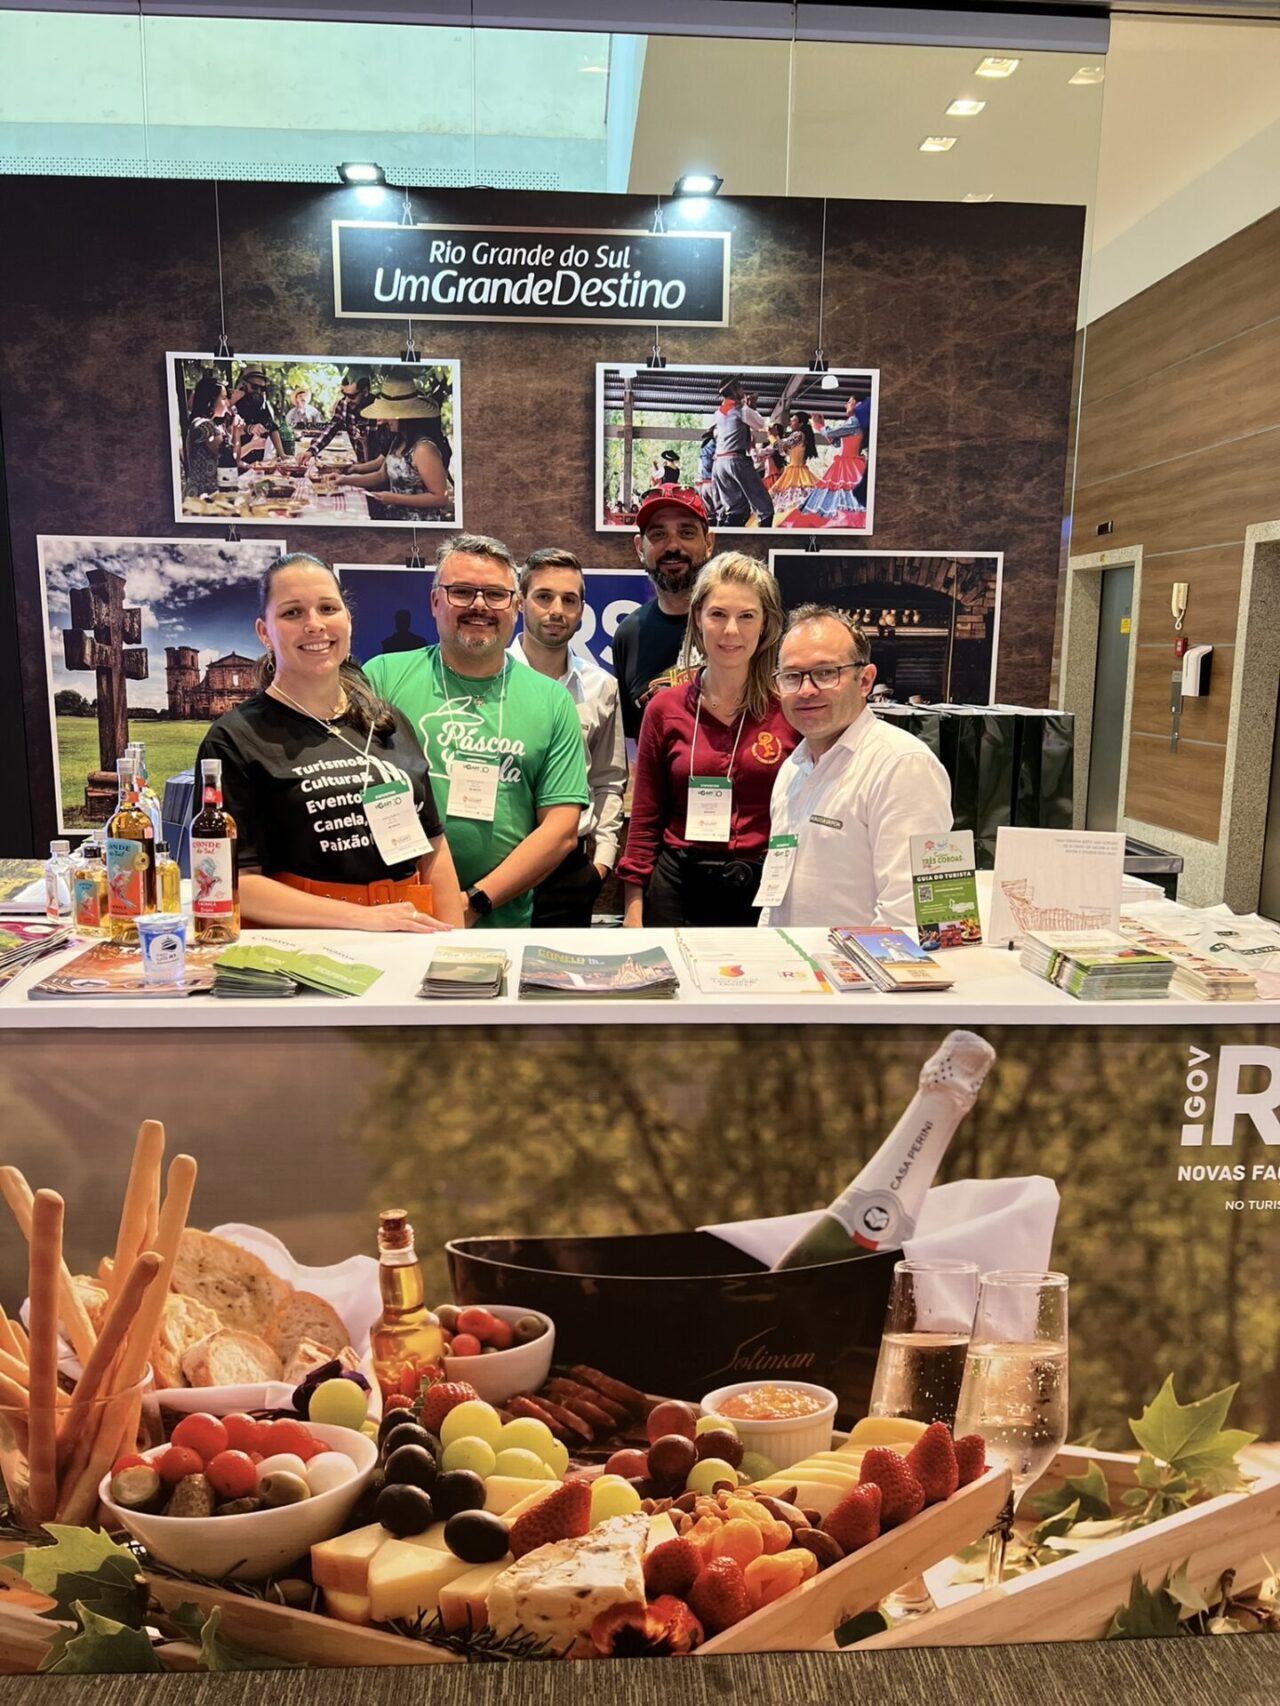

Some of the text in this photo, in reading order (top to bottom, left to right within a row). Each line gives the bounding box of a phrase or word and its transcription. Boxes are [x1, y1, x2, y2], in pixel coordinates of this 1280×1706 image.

[428, 240, 631, 269] Rio Grande do Sul
[437, 722, 526, 757] Páscoa
[933, 873, 944, 881] DO
[944, 871, 972, 880] TURISTA
[1184, 1045, 1212, 1119] GOV
[890, 1120, 935, 1191] CASA PERINI
[1177, 1164, 1280, 1181] NOVAS FA
[1225, 1200, 1245, 1211] NO
